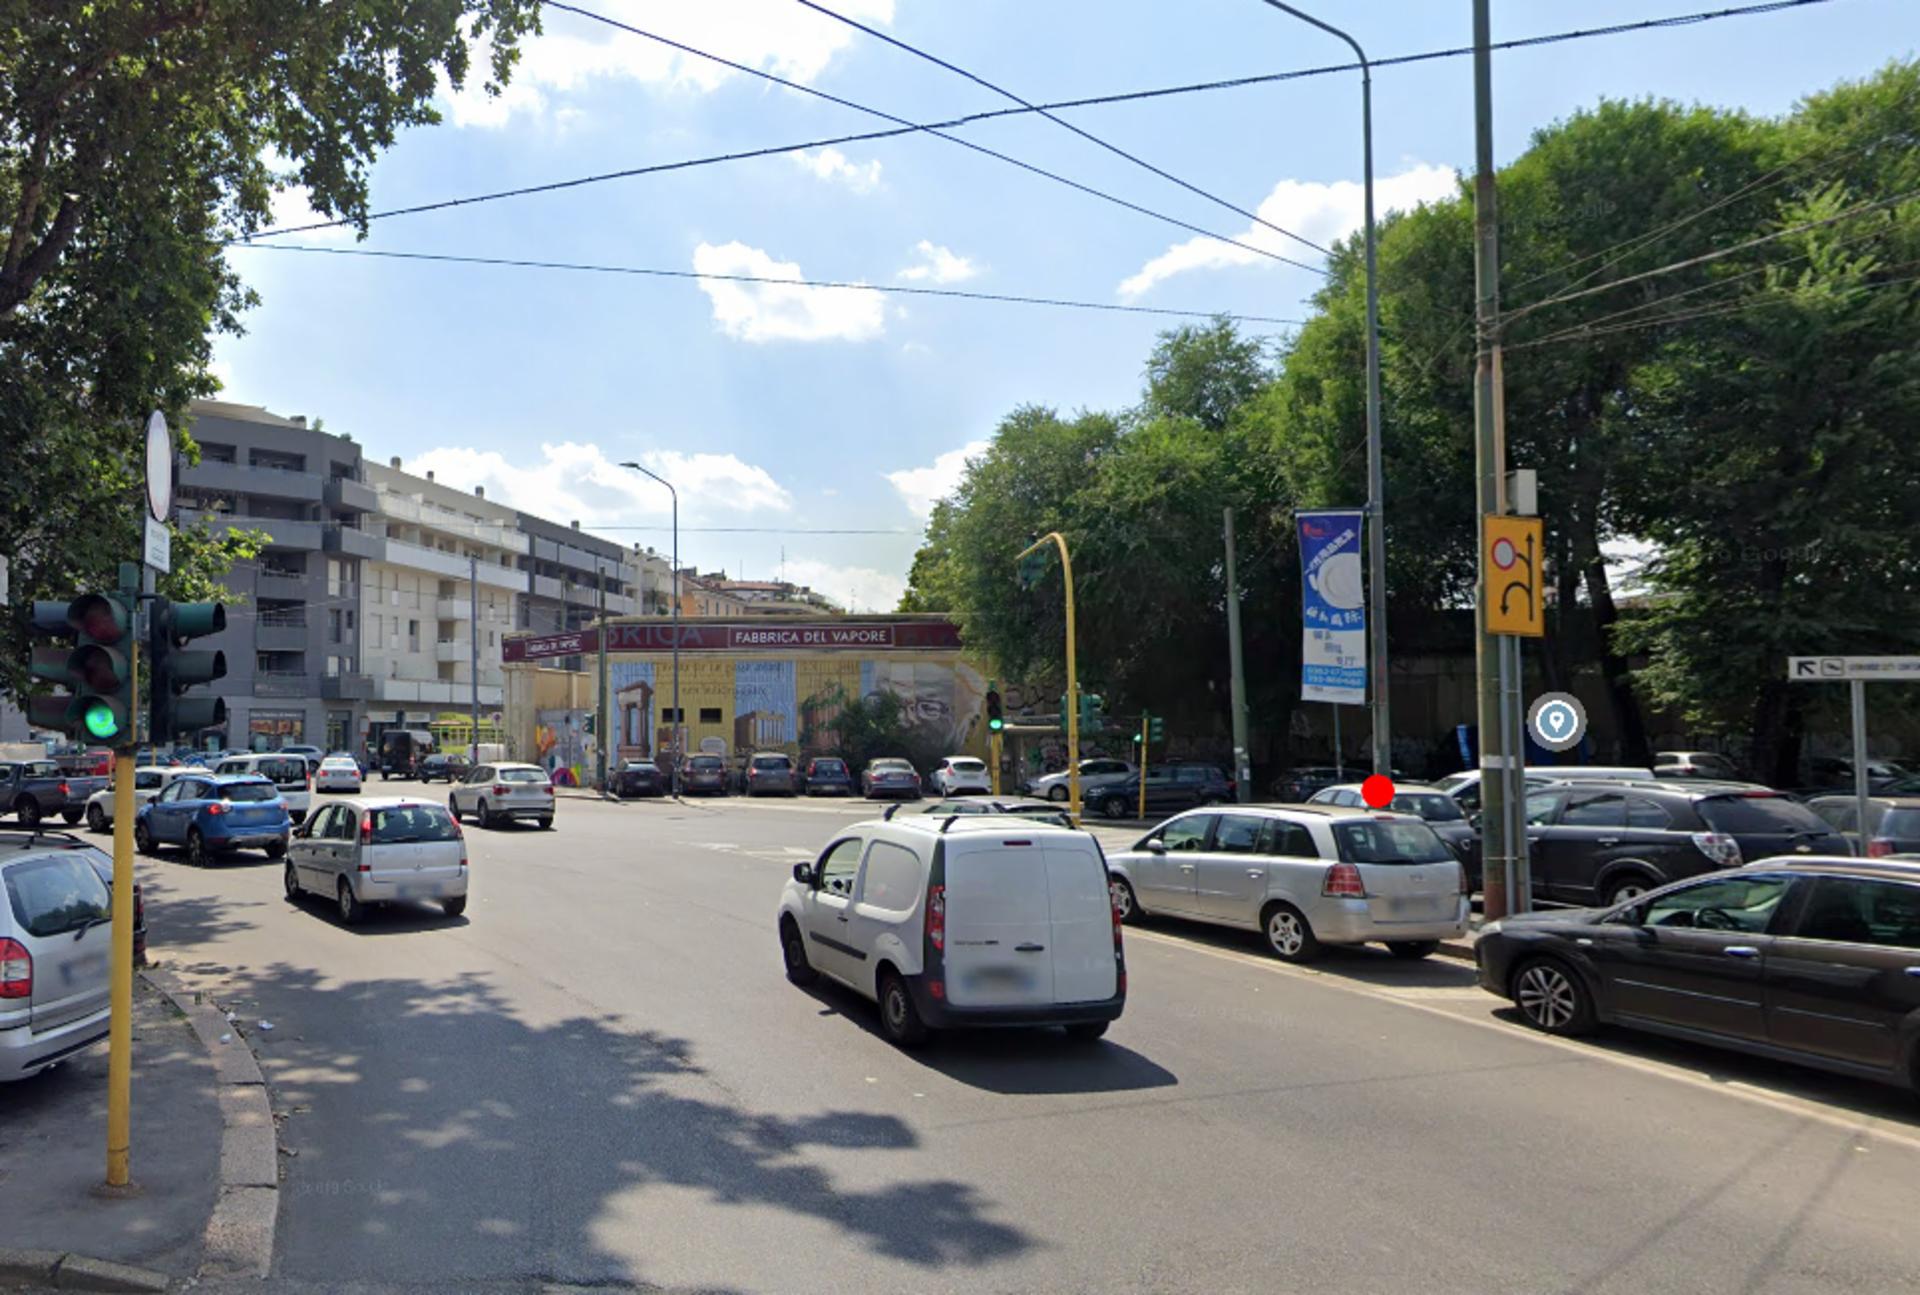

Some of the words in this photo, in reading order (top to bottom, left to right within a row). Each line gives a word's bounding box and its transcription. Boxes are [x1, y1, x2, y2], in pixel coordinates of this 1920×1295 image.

[735, 631, 799, 644] FABBRICA
[803, 631, 825, 643] DEL
[832, 630, 887, 642] VAPORE
